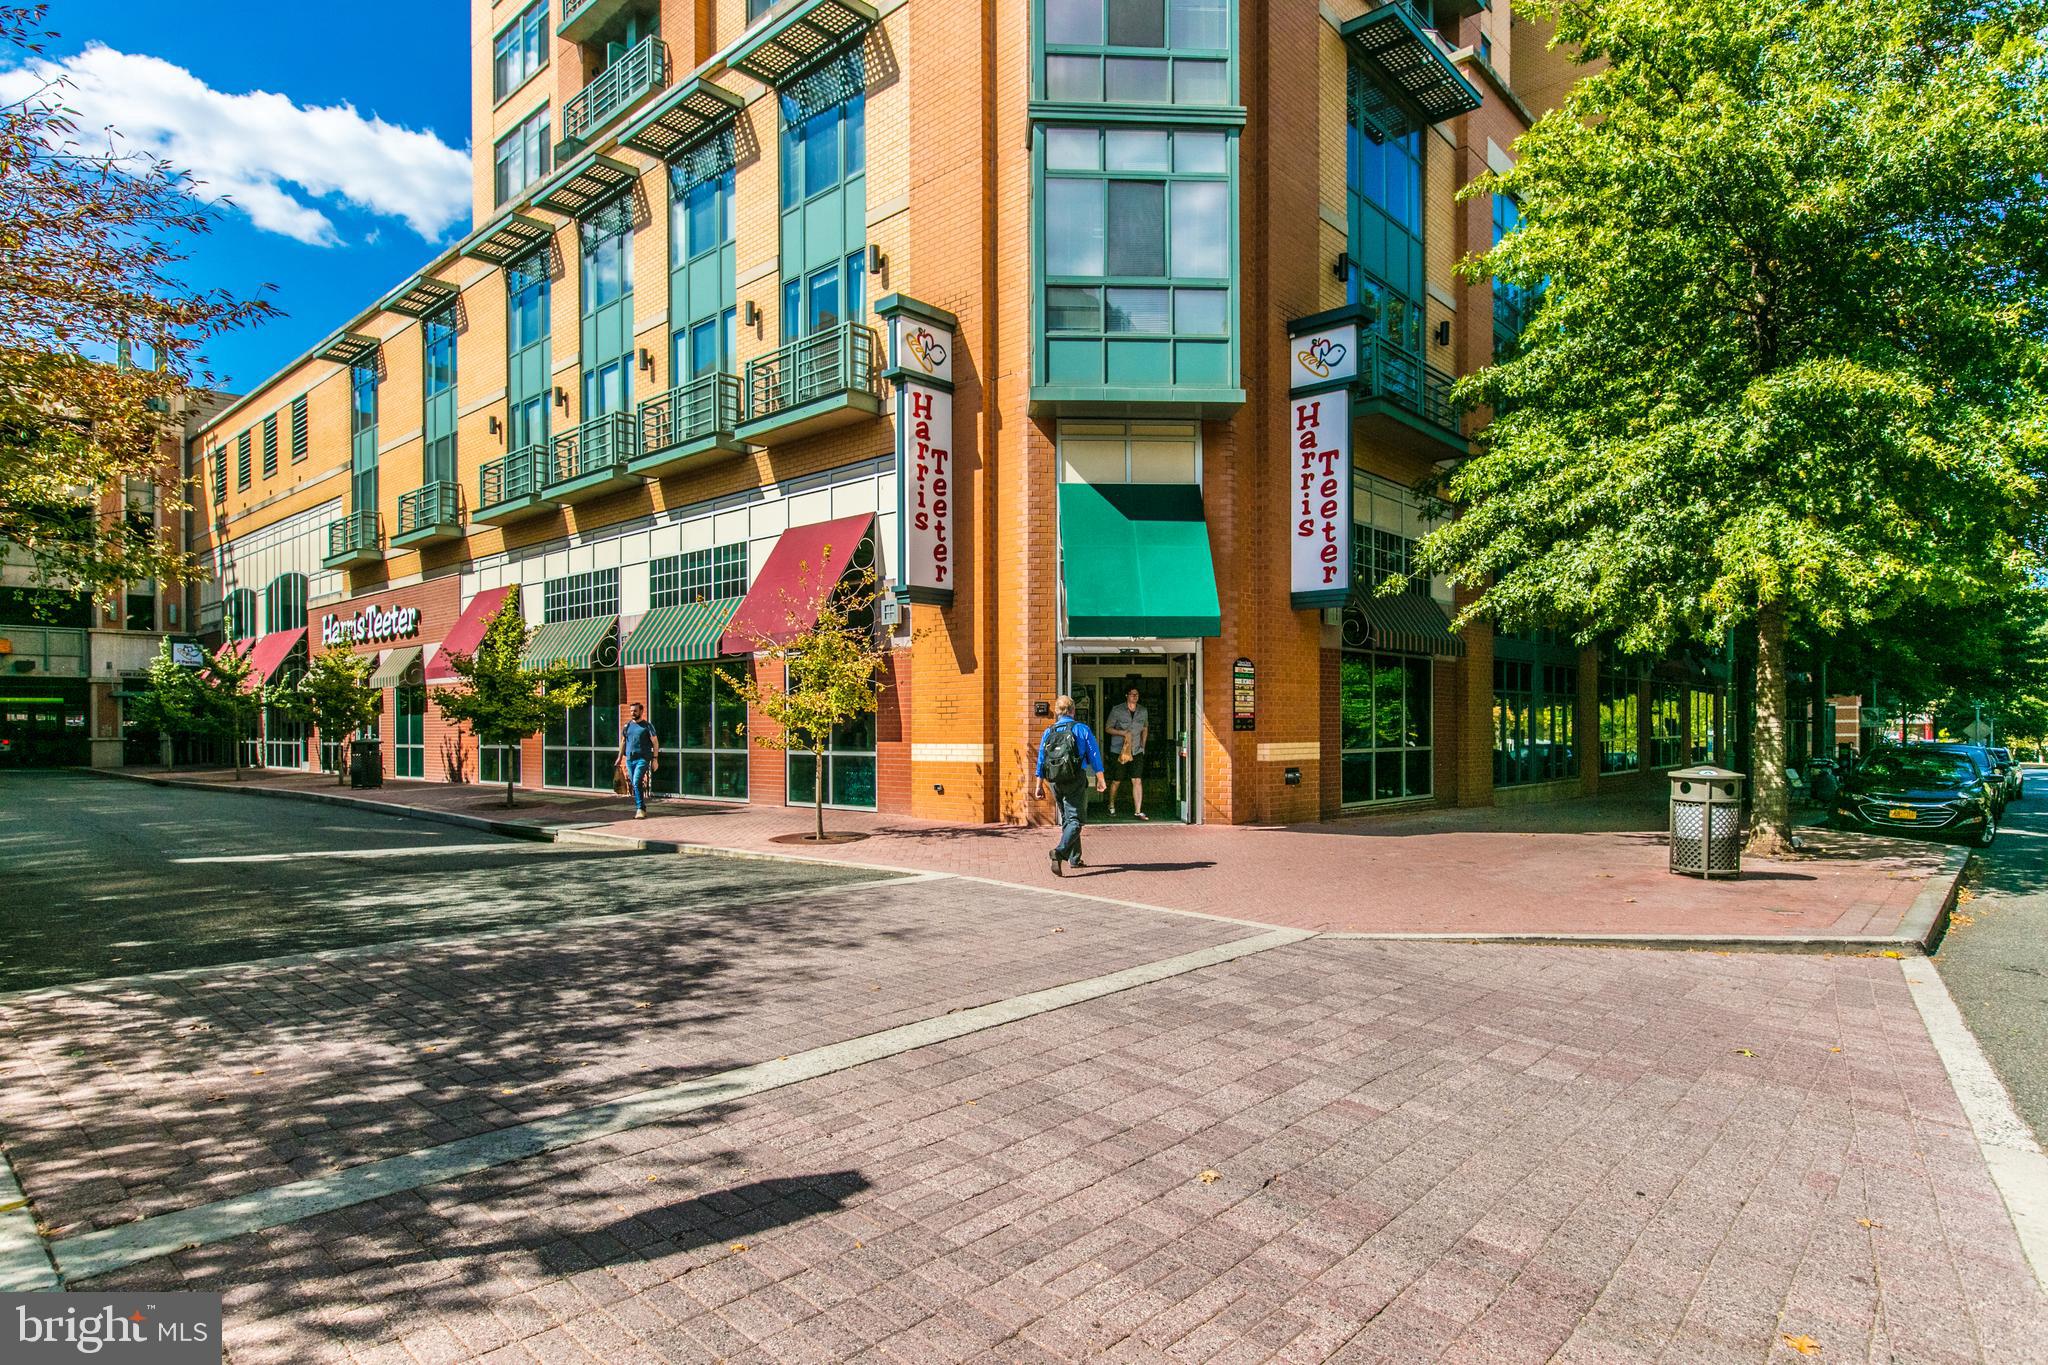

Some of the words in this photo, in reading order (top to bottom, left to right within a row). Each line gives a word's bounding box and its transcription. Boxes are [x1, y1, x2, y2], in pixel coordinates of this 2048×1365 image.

[912, 391, 933, 531] Harris
[930, 448, 949, 583] Teeter
[1296, 401, 1320, 538] Harris
[1318, 449, 1340, 584] Teeter
[322, 611, 366, 646] Harris
[366, 604, 418, 640] Teeter
